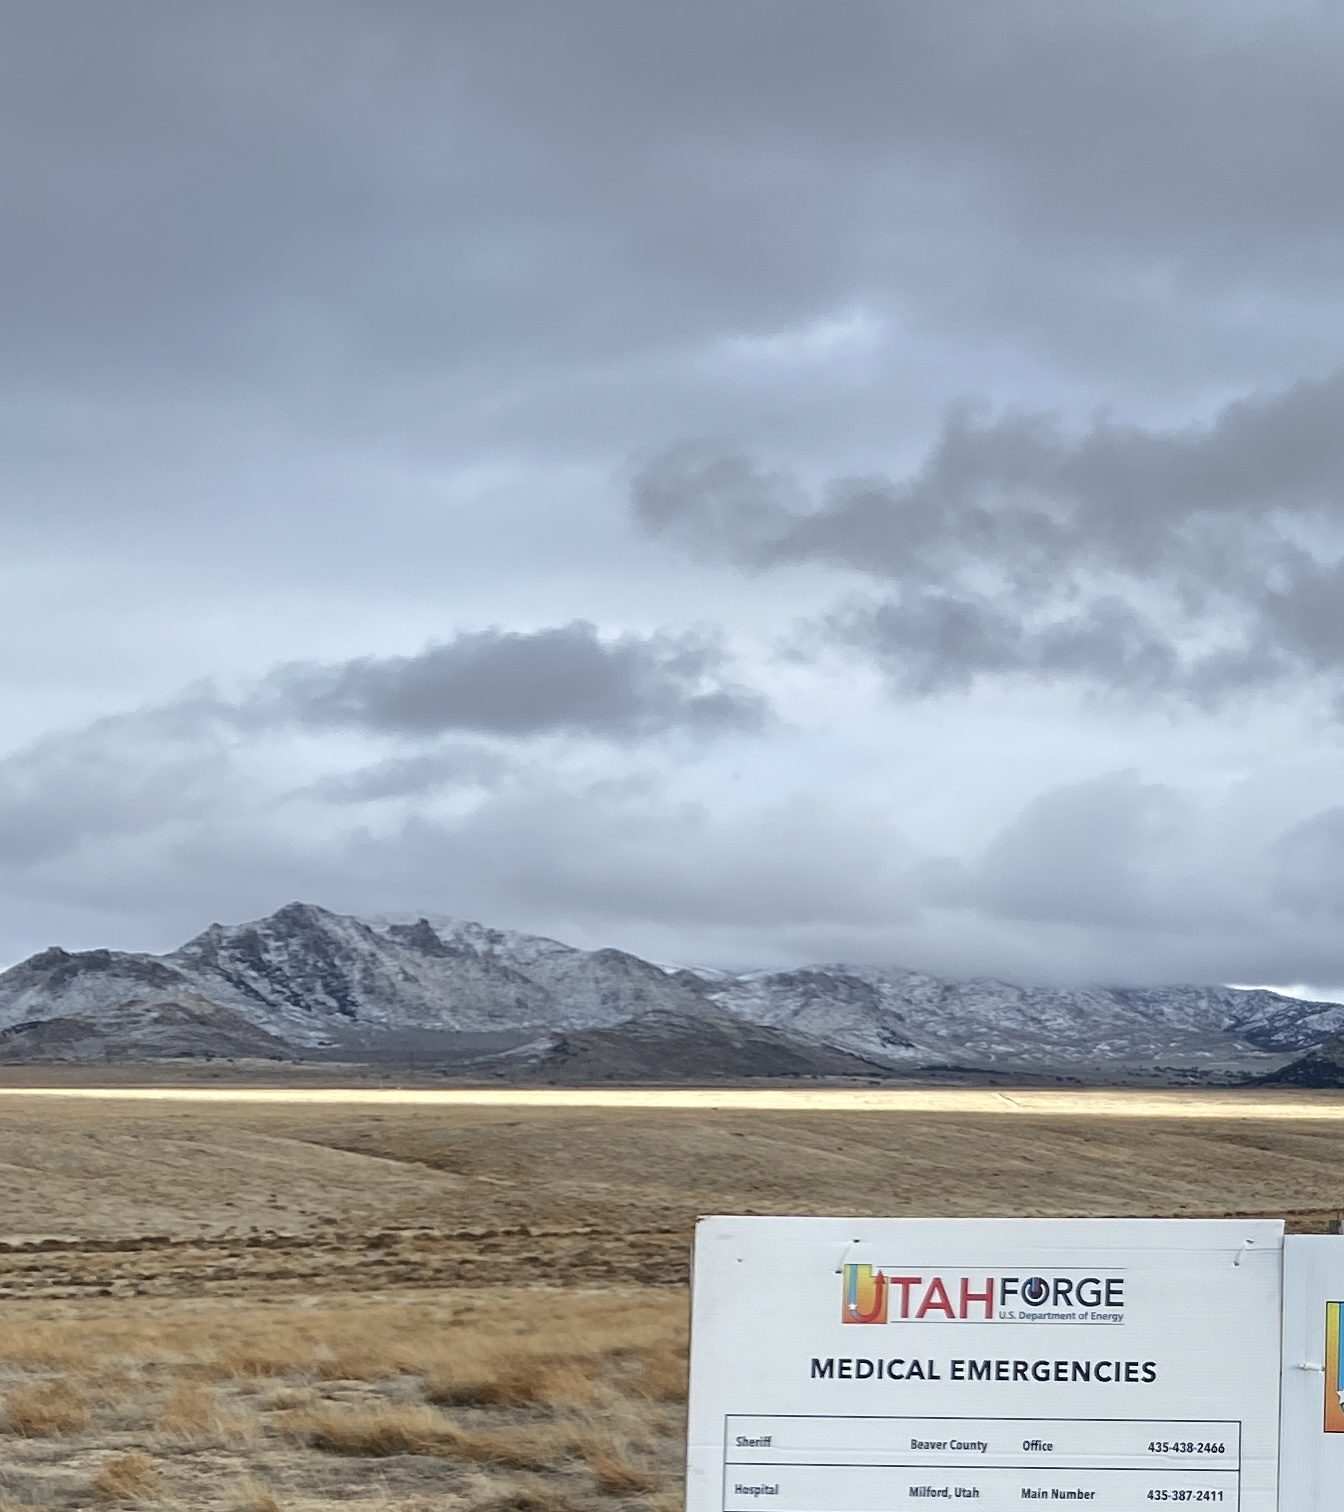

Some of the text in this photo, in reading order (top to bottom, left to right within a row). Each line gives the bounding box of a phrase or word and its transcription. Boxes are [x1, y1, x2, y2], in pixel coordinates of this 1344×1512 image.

[998, 1310, 1124, 1324] U.S. Department of Energy
[810, 1358, 1157, 1383] MEDICAL EMERGENCIES
[735, 1435, 1226, 1454] Sheriff Beaver County Office 435-438-2466
[734, 1483, 1223, 1502] Hospital Milford, Utah Main Number 435-387-2411
